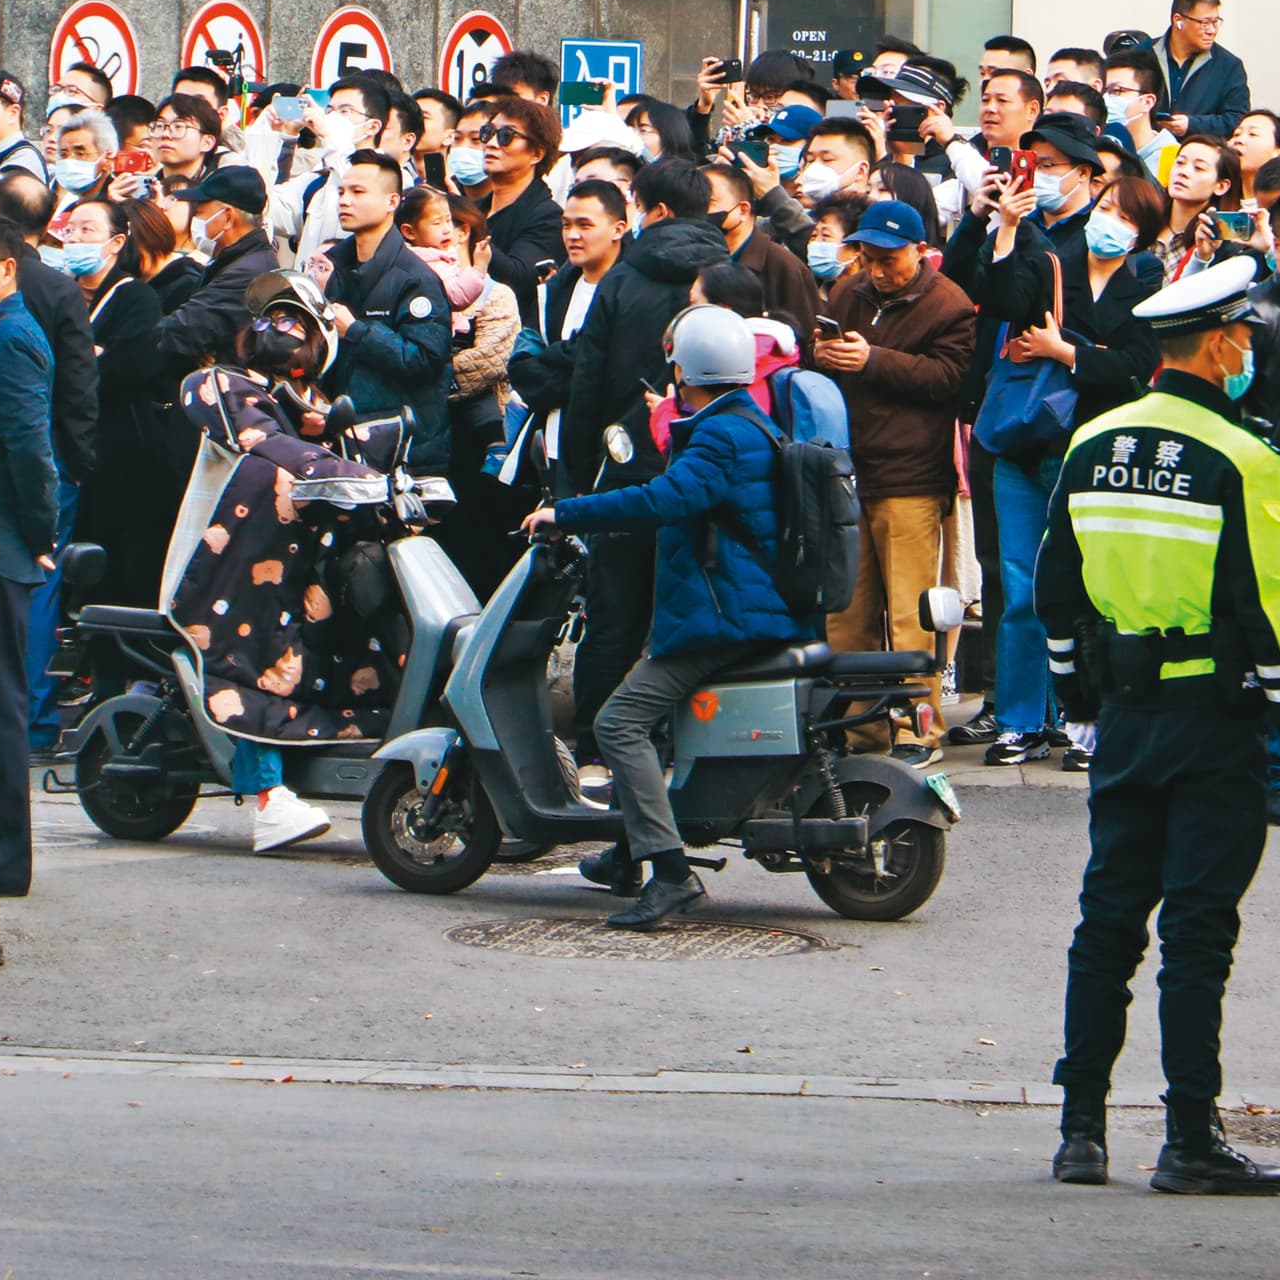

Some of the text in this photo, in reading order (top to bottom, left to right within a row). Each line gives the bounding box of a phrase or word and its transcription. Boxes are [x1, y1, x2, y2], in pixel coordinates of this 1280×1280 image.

[792, 30, 828, 41] OPEN
[1111, 434, 1185, 469] 警察
[1092, 465, 1192, 496] POLICE
